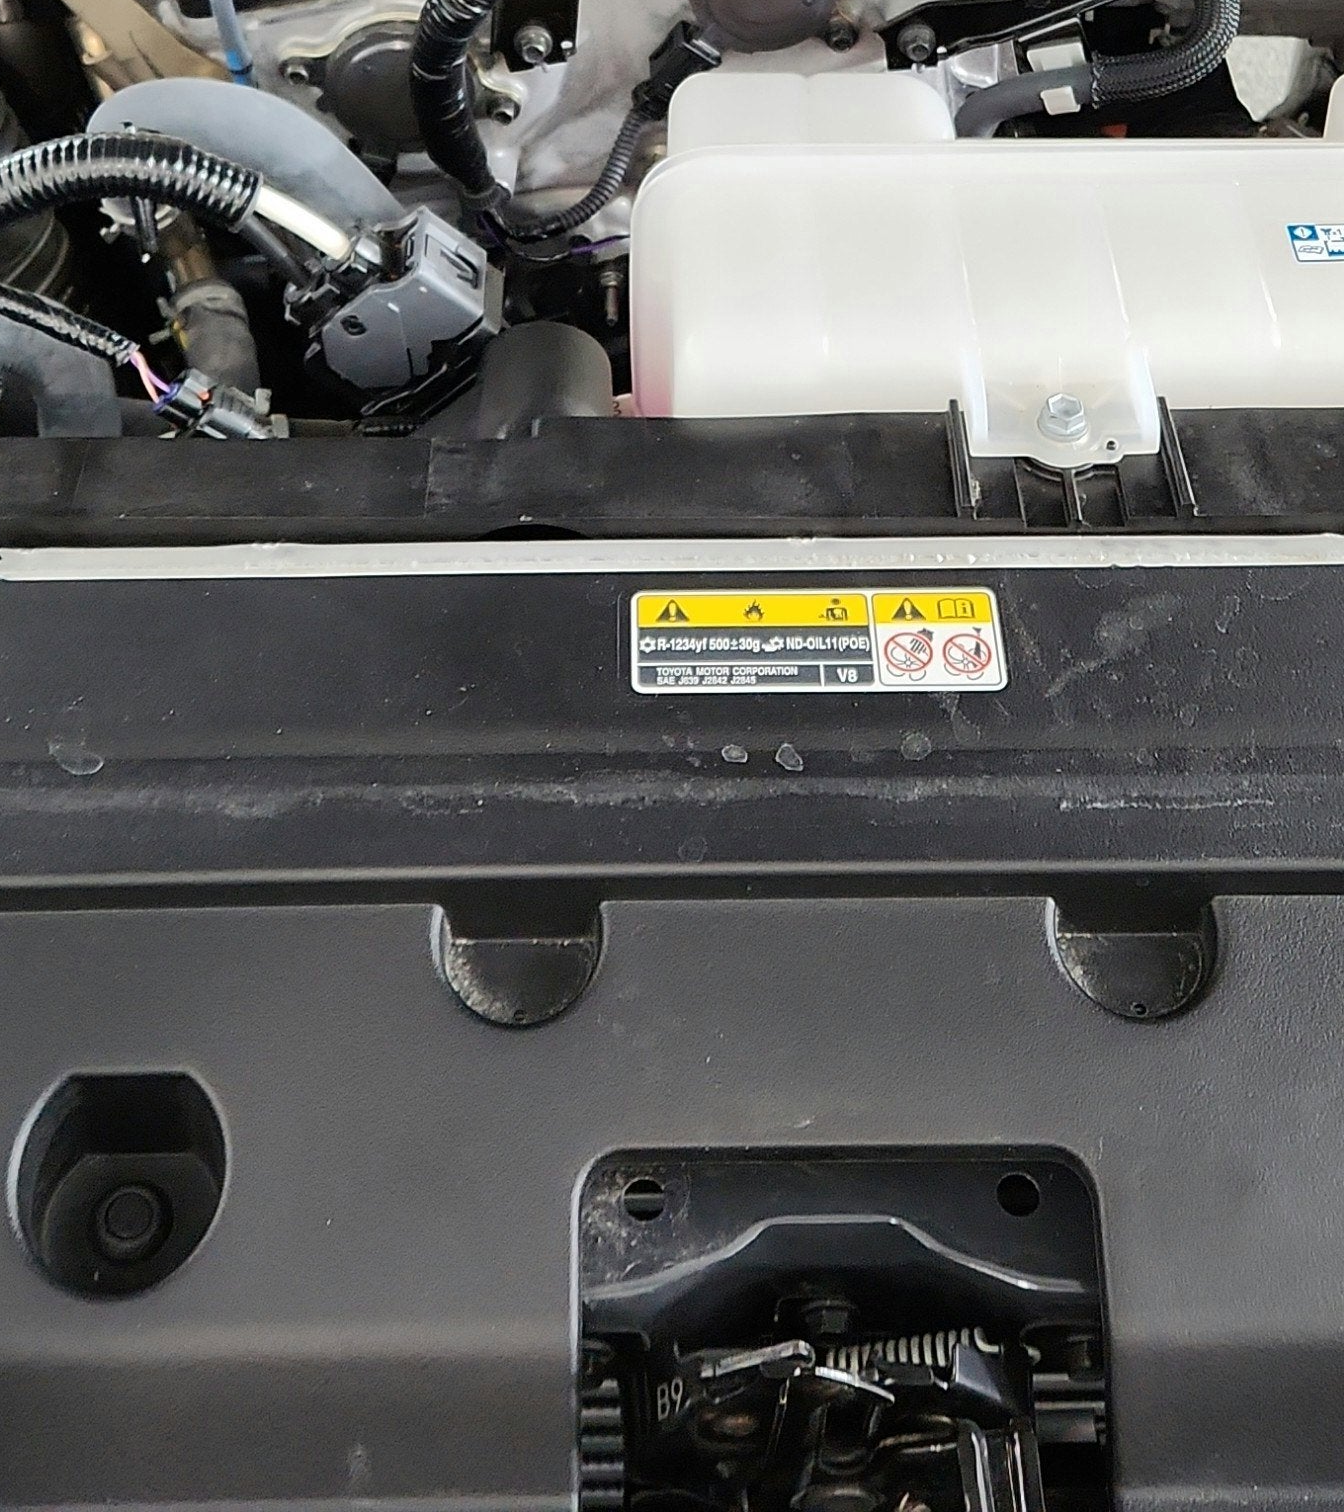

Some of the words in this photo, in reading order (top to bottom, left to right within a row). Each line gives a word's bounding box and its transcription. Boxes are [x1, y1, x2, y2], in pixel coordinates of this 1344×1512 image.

[657, 637, 707, 653] R-1234yf
[709, 637, 760, 653] 500±30g
[786, 635, 870, 651] ND-OIL11(POE)
[656, 666, 693, 676] TOYOTA
[696, 666, 729, 676] MOTOR
[732, 665, 798, 676] CORPORATION
[837, 667, 858, 683] V8
[656, 676, 675, 685] SAE
